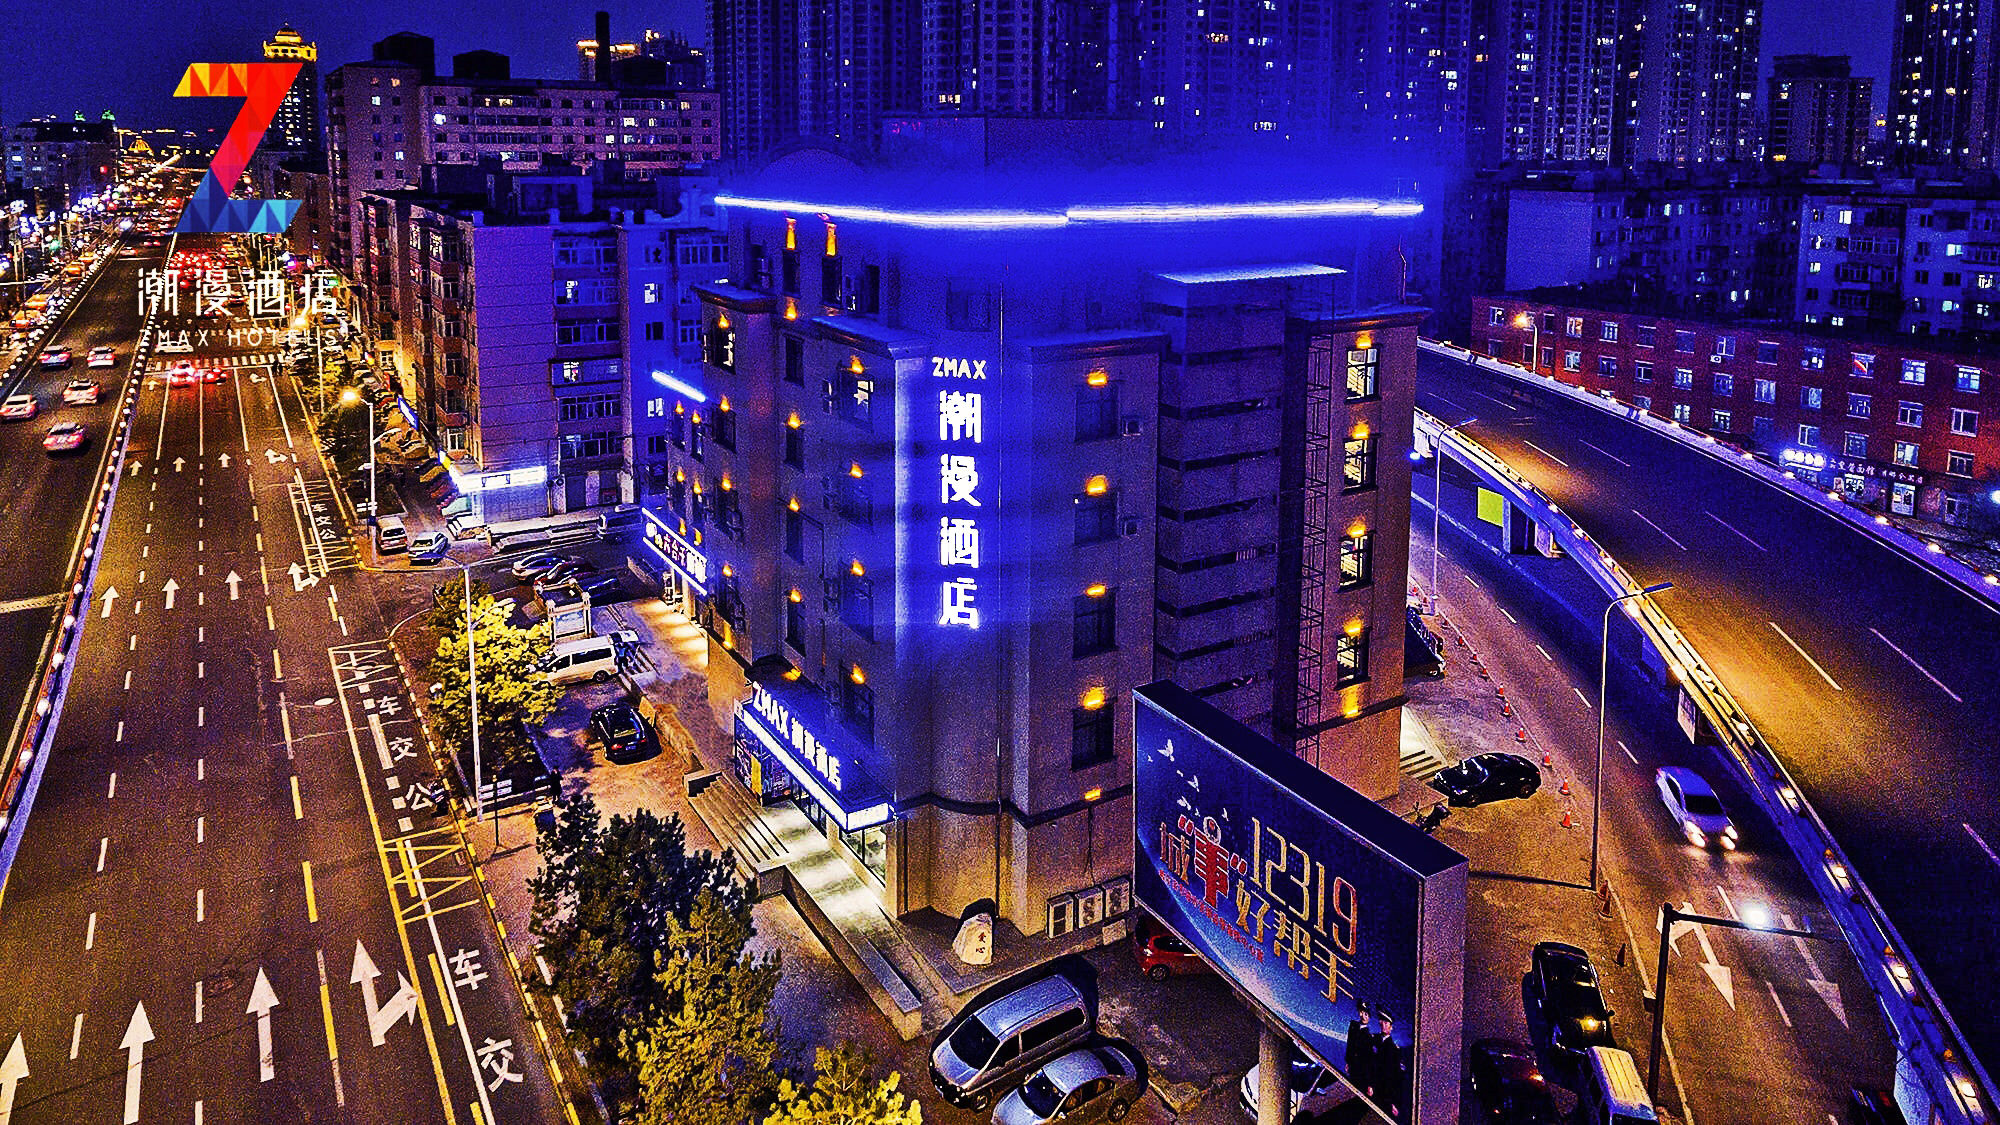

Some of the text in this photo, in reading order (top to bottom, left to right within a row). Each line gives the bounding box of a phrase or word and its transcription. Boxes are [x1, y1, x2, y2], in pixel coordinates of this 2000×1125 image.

[931, 356, 987, 380] ZMAX
[939, 389, 982, 629] 潮漫酒店
[752, 680, 790, 740] ZMAX
[1250, 816, 1358, 956] 12319
